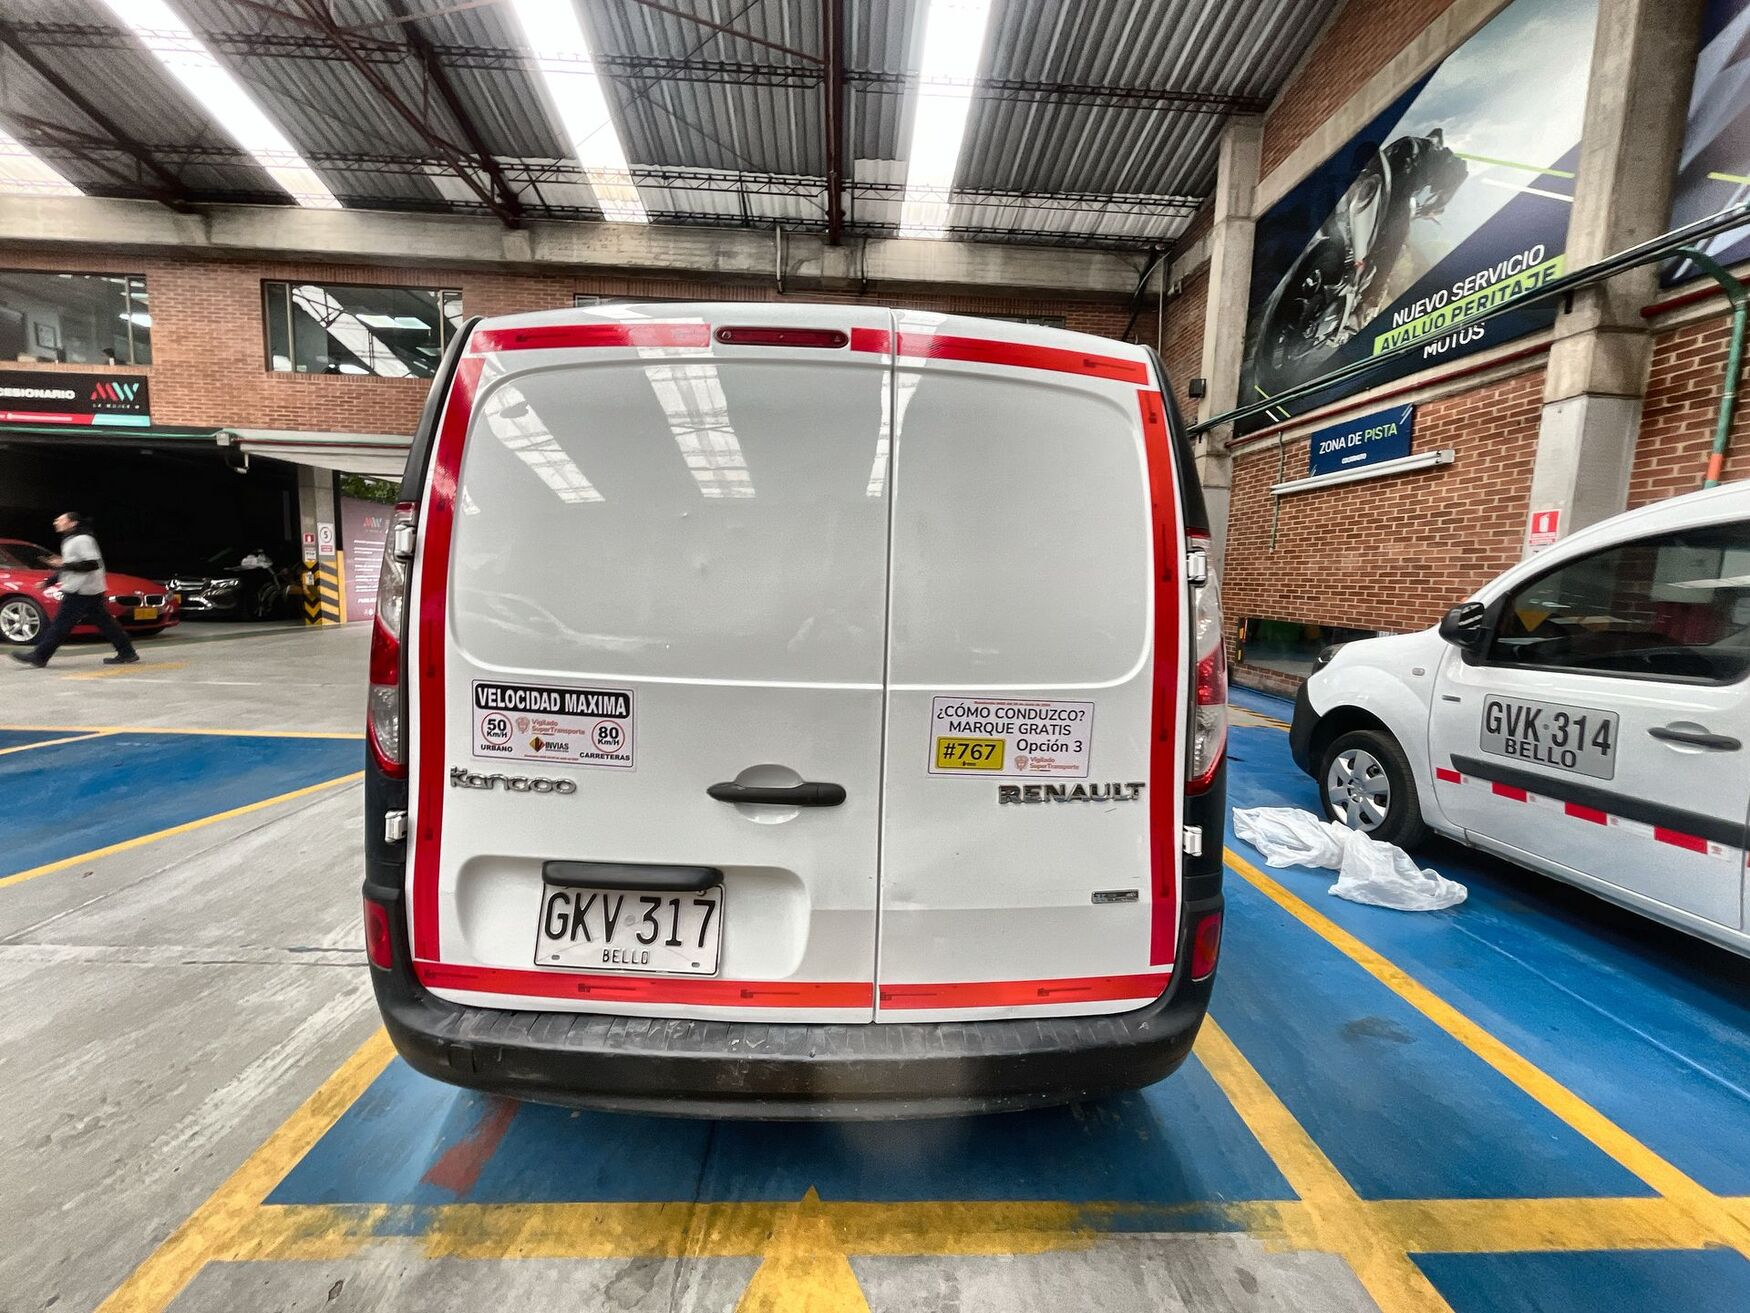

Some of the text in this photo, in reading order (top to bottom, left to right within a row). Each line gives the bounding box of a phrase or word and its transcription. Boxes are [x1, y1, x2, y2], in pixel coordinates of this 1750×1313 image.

[1392, 244, 1546, 329] NUEVO SERVICIO
[1380, 263, 1558, 353] AVALÚO PERITAJE
[1319, 422, 1398, 455] ZONA DE PISTA
[477, 687, 627, 716] VELOCIDAD MAXIMA
[936, 703, 991, 720] ¿CÓMO
[995, 707, 1086, 722] CONDUZCO?
[487, 718, 507, 732] 50
[531, 718, 559, 727] Vigilado
[531, 726, 585, 735] SuperTransporte
[949, 721, 1072, 736] MARQUE GRATIS
[1486, 701, 1611, 756] GVK 314
[487, 730, 508, 739] Km/H
[598, 726, 620, 740] 80
[480, 744, 513, 753] URBANO
[545, 742, 569, 750] INVIAS
[597, 738, 620, 746] Km/H
[1016, 738, 1083, 754] Opción 3
[579, 751, 631, 762] CARRETERAS
[943, 743, 997, 761] #767
[1030, 756, 1056, 764] Vigilado
[1505, 737, 1577, 768] BELLO
[998, 782, 1146, 805] RENAULT
[544, 891, 716, 948] GKV 317
[601, 948, 650, 965] BELLO
